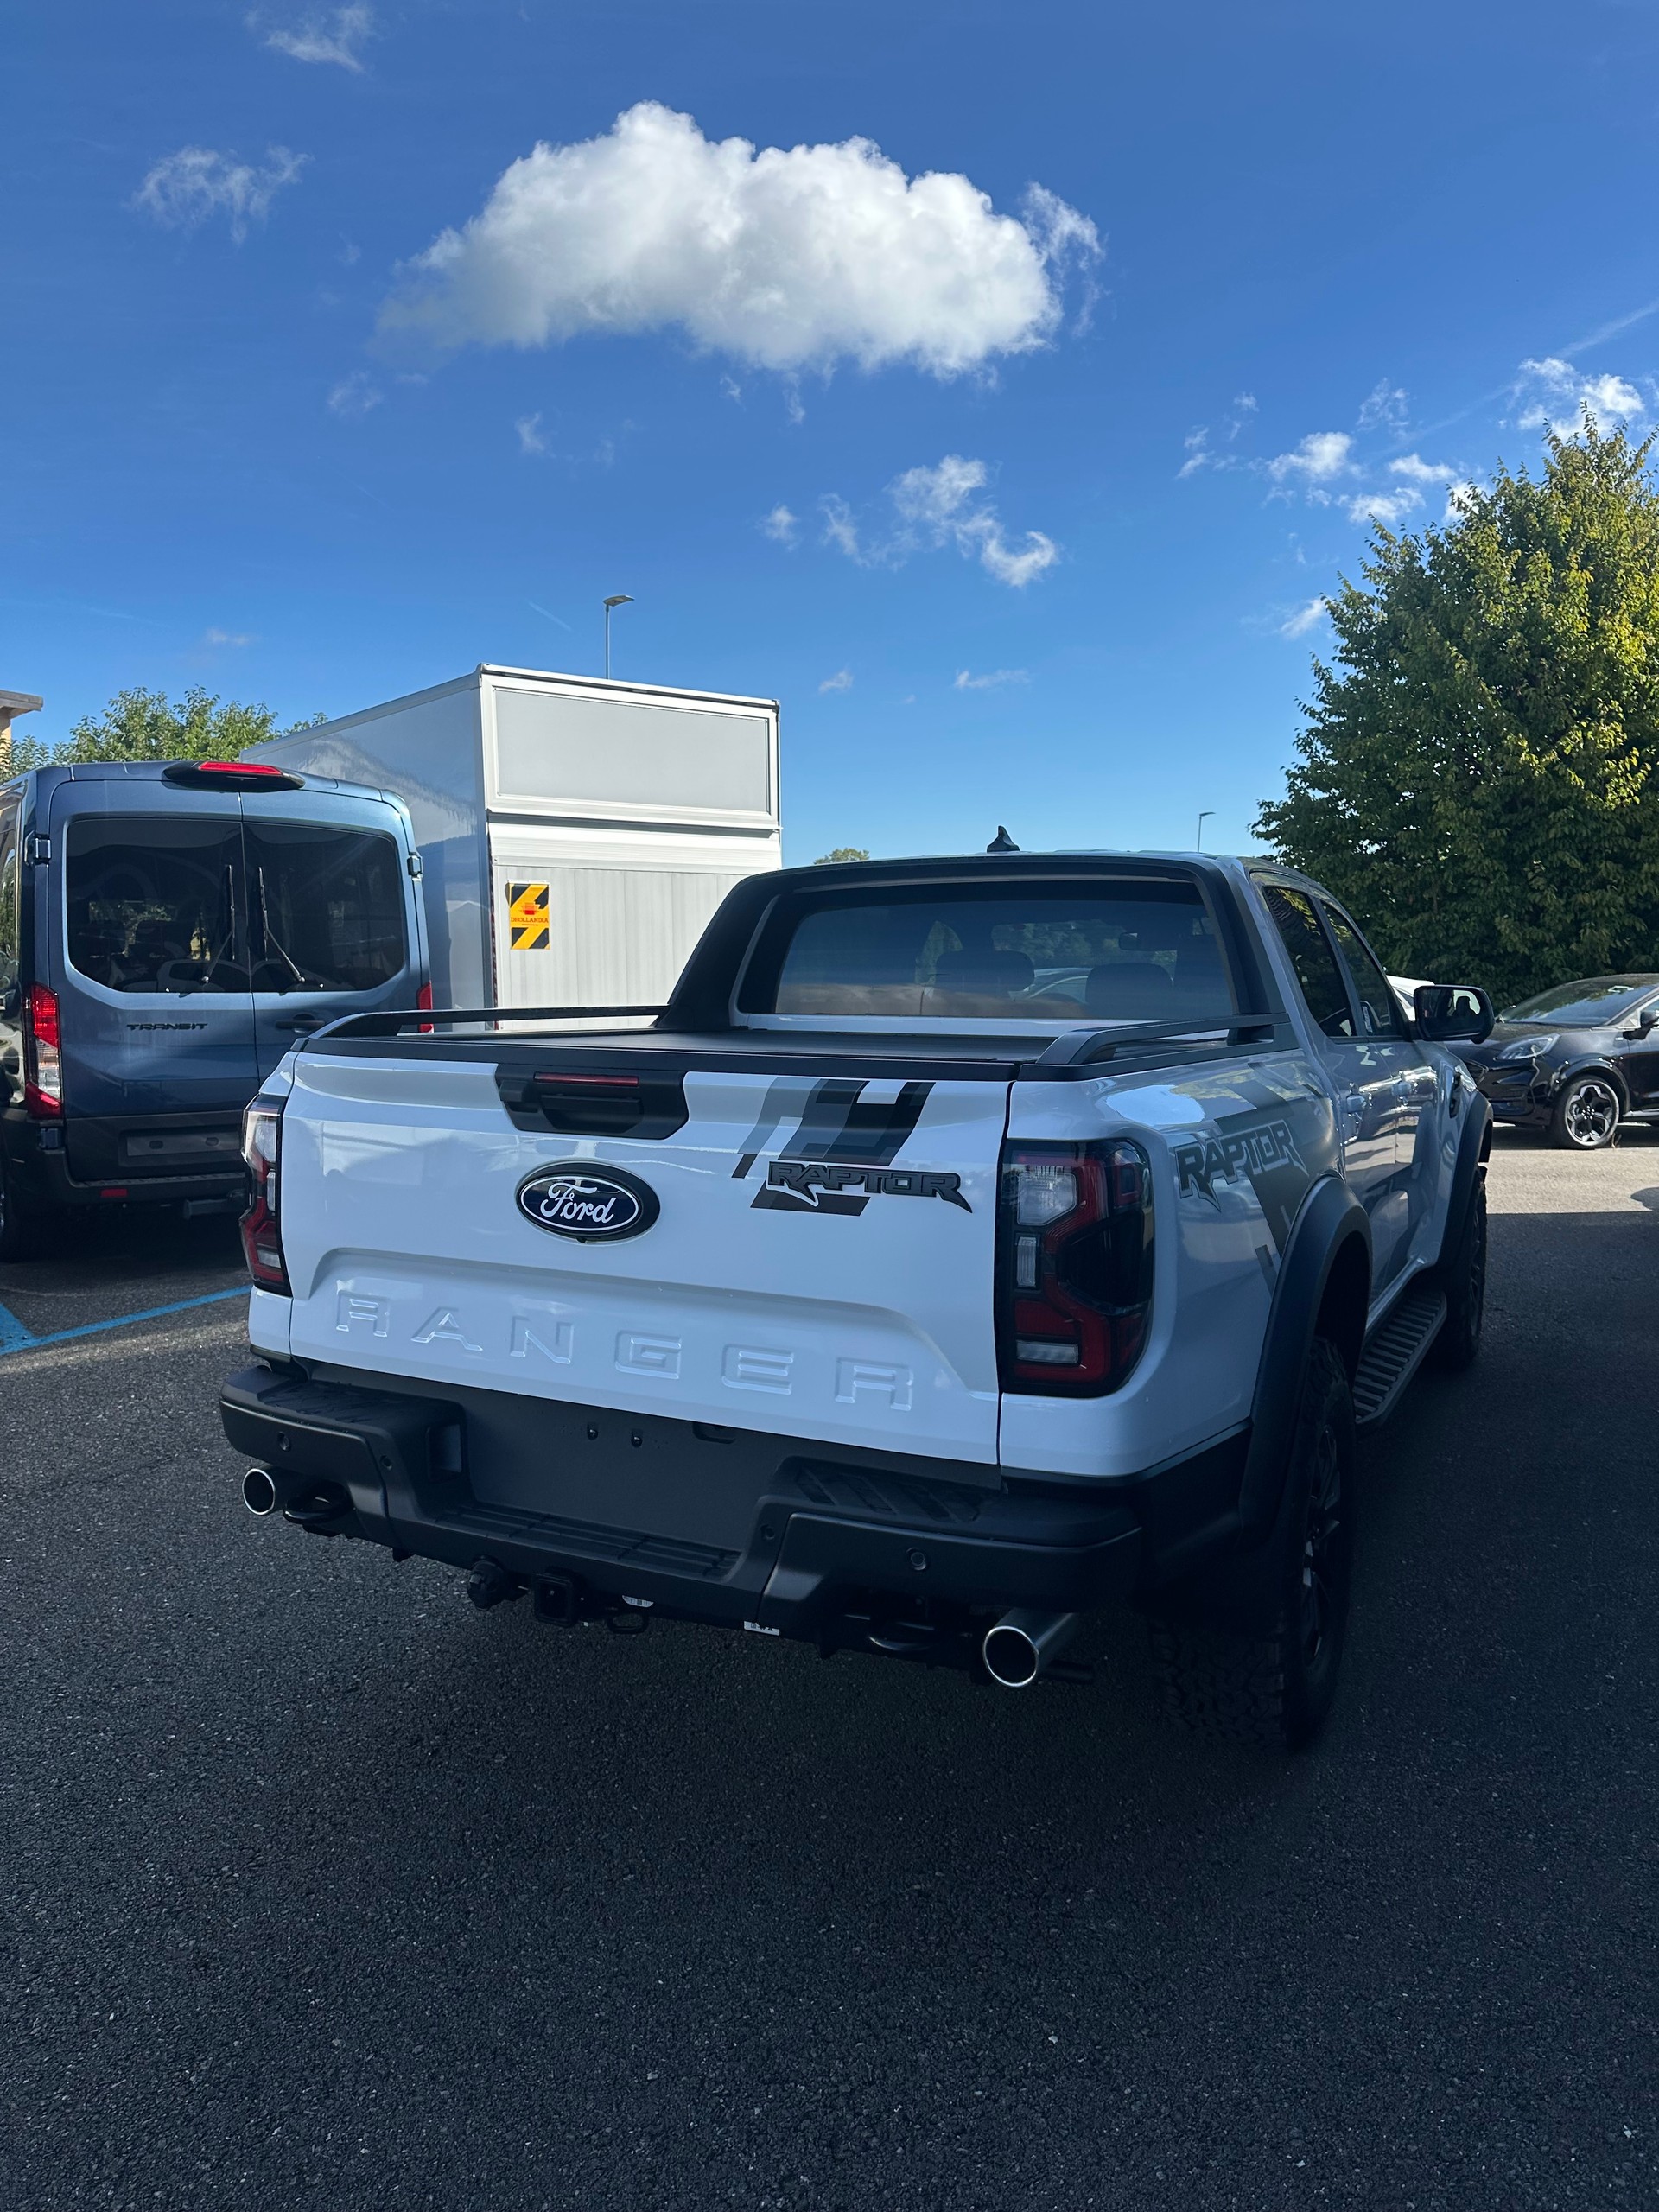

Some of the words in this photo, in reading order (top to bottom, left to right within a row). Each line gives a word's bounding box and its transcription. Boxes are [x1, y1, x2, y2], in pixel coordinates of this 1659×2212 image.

[768, 1160, 973, 1214] RAPTOR
[1174, 1119, 1309, 1212] RAPTOR
[540, 1182, 617, 1224] Ford
[335, 1294, 914, 1412] RANGER
